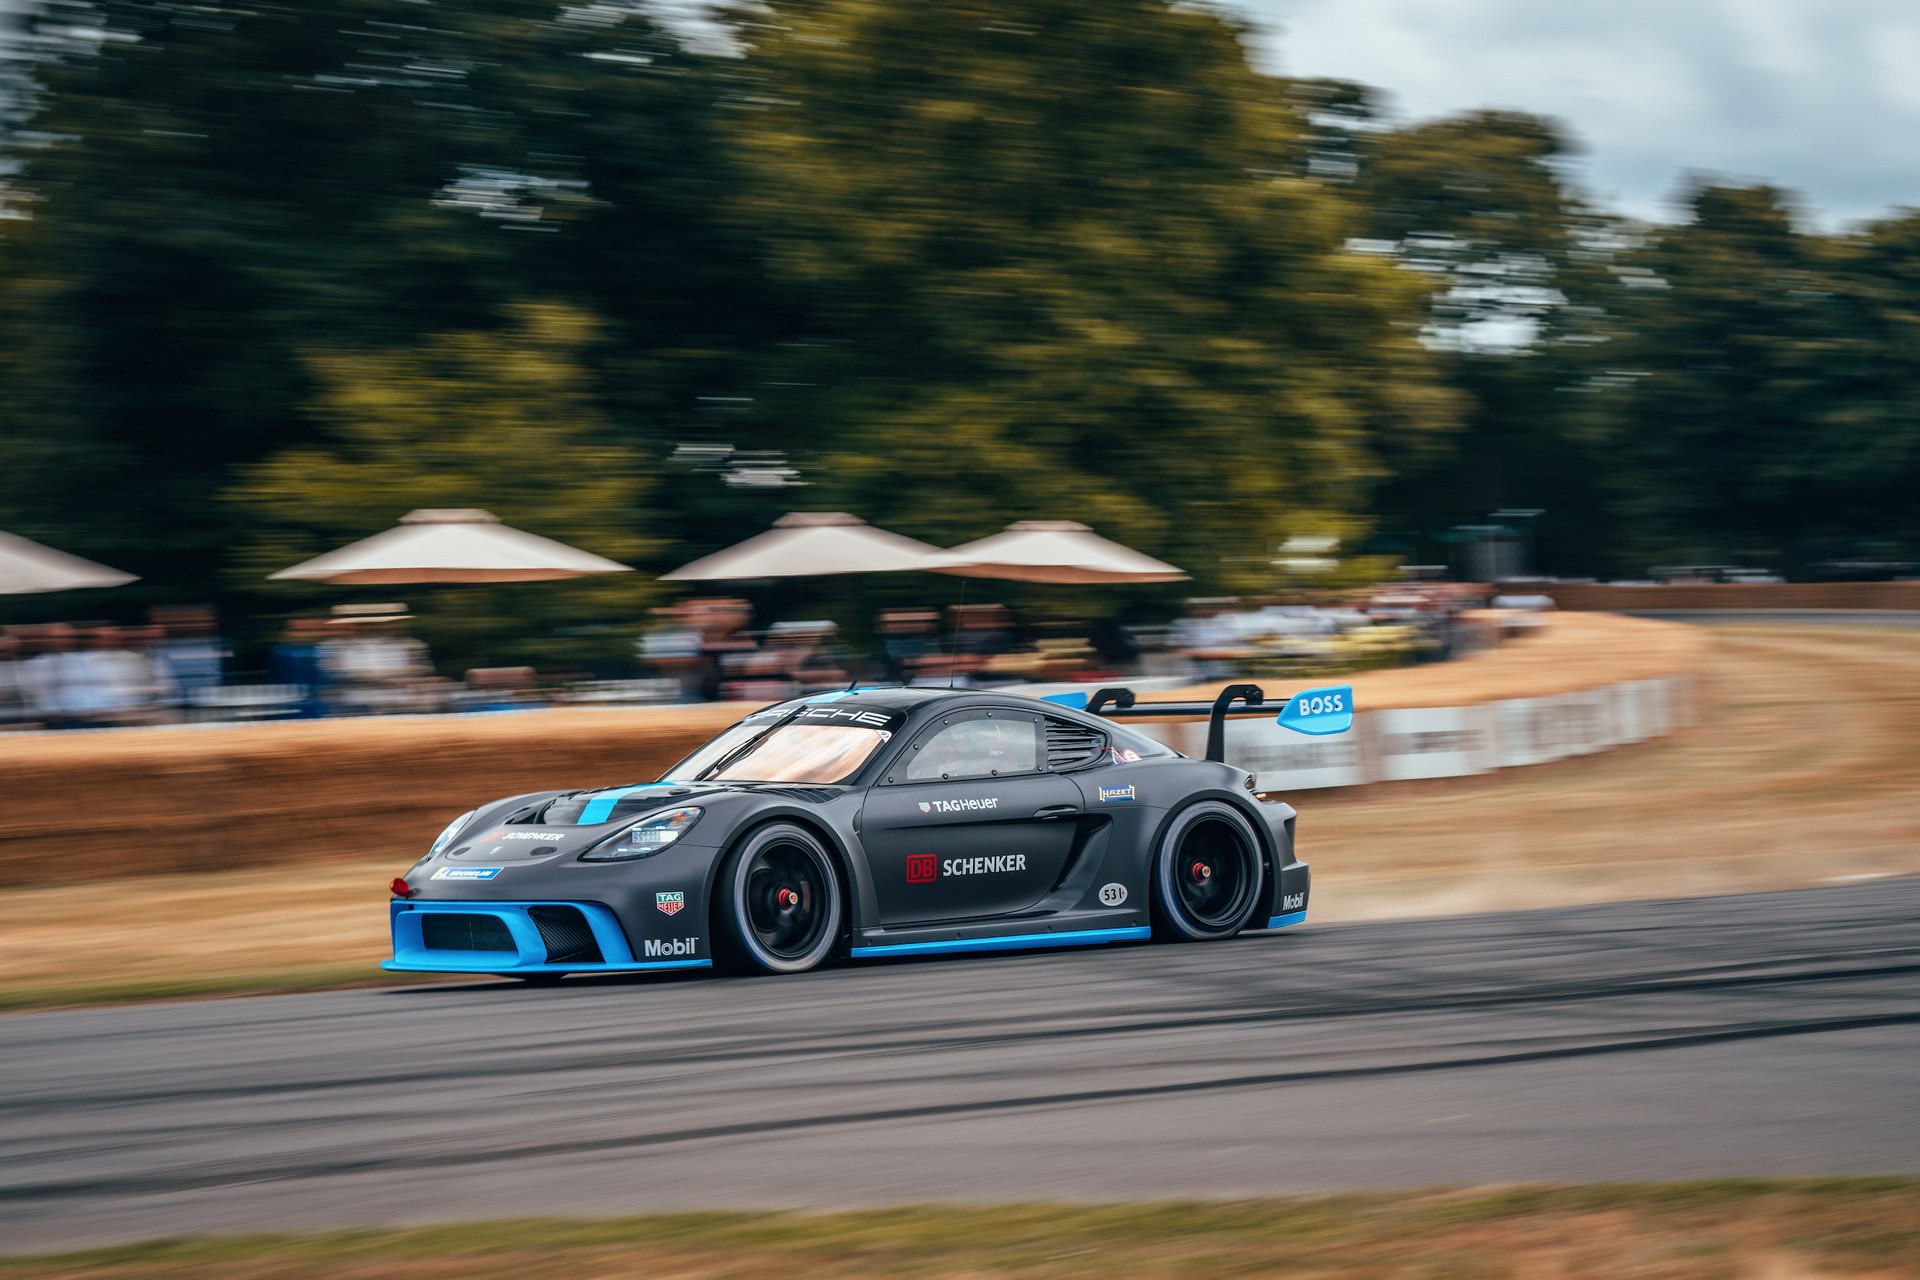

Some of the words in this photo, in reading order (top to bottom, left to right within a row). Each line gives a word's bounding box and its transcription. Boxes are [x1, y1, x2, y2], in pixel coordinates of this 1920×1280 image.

[1299, 694, 1344, 716] BOSS
[1103, 788, 1131, 798] HAZET
[910, 859, 933, 879] DB
[942, 854, 1026, 877] SCHENKER
[659, 893, 681, 901] TAG
[1104, 887, 1122, 901] 531
[1282, 892, 1304, 911] Mobil
[658, 901, 683, 914] HEUER
[644, 937, 697, 957] Mobil
